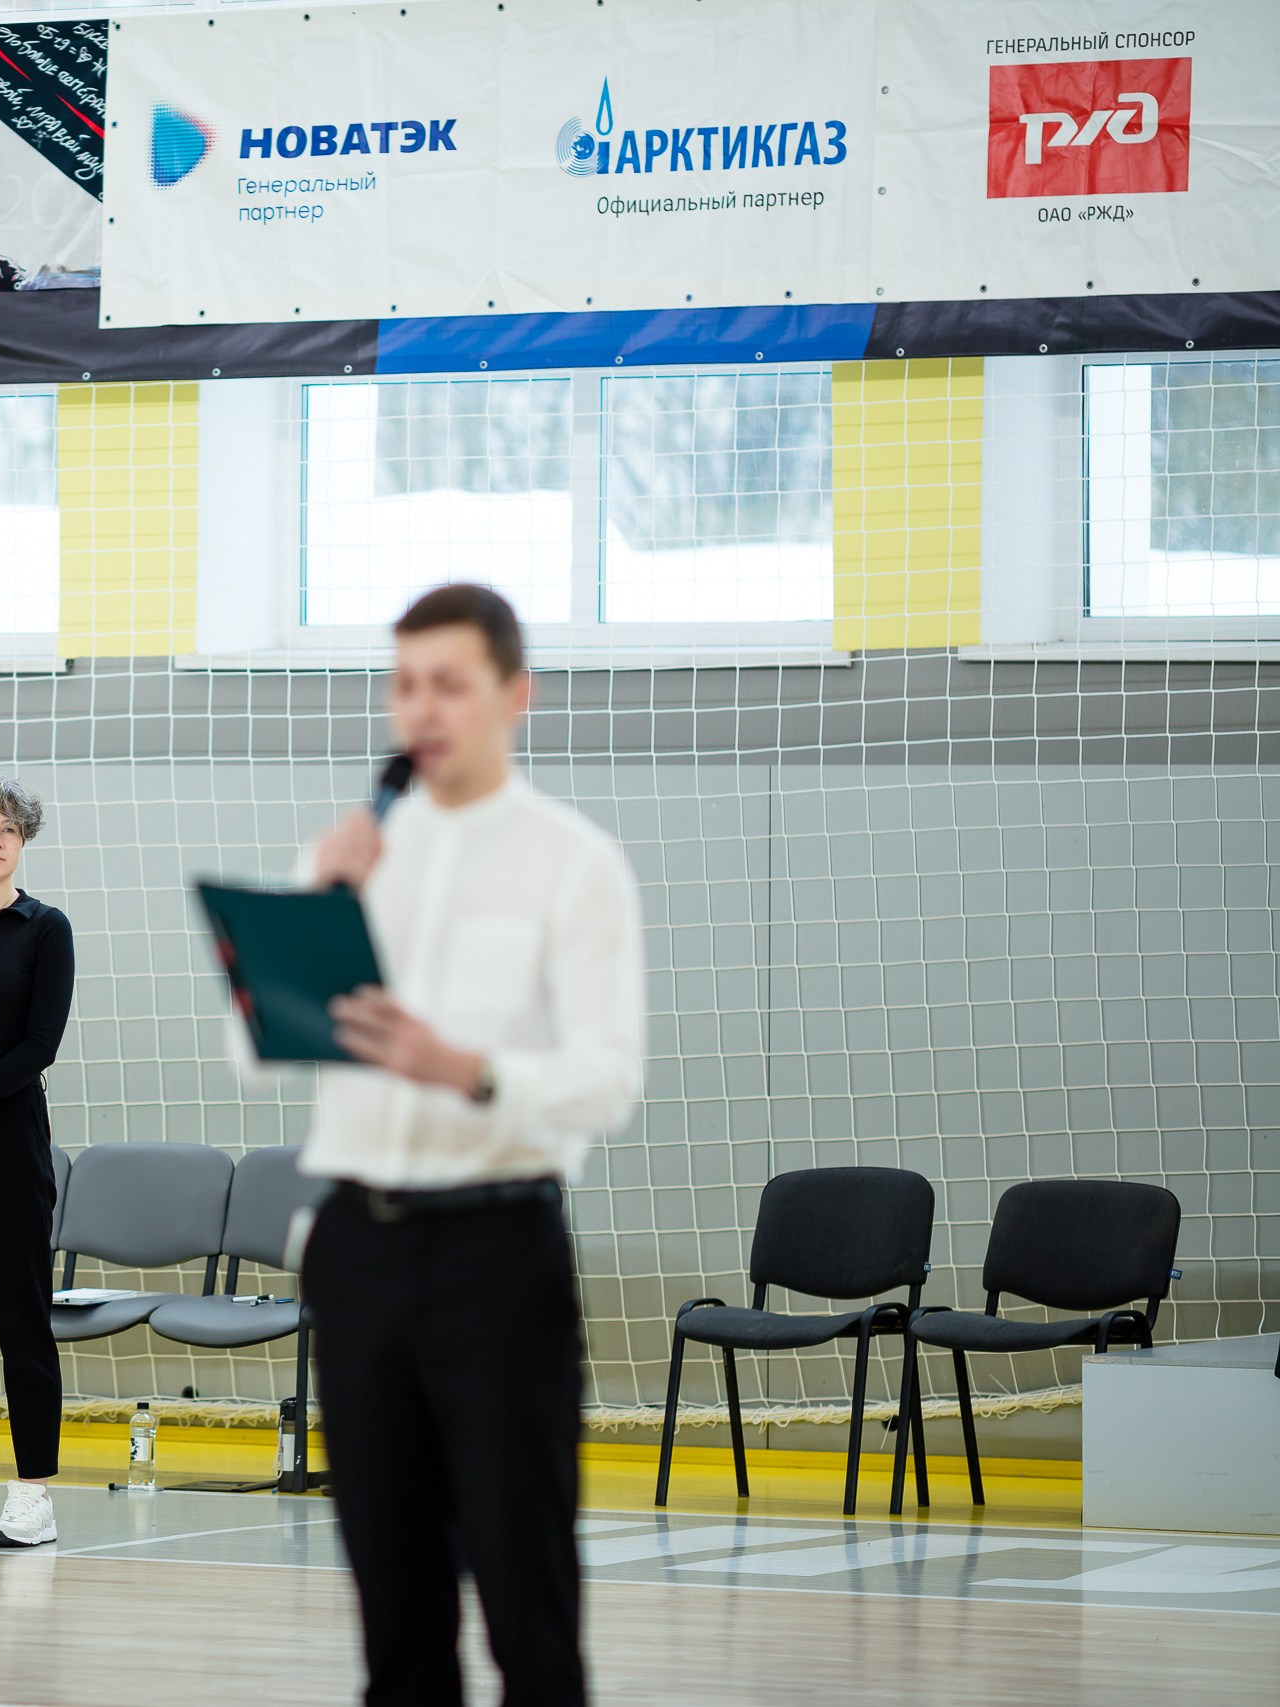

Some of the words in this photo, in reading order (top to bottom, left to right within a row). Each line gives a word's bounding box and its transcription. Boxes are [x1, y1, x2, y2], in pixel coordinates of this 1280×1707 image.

[986, 31, 1110, 54] ГЕНЕРАЛЬНЫЙ
[1115, 31, 1196, 49] СПОНСОР
[239, 118, 458, 159] НОВАТЭК
[614, 120, 847, 174] АРКТИКГАЗ
[237, 171, 377, 197] Генеральный
[239, 204, 324, 225] партнер
[596, 191, 736, 217] Официальный
[742, 191, 825, 210] партнер
[1038, 207, 1072, 222] ОАО
[1078, 205, 1134, 221] «РЖД»
